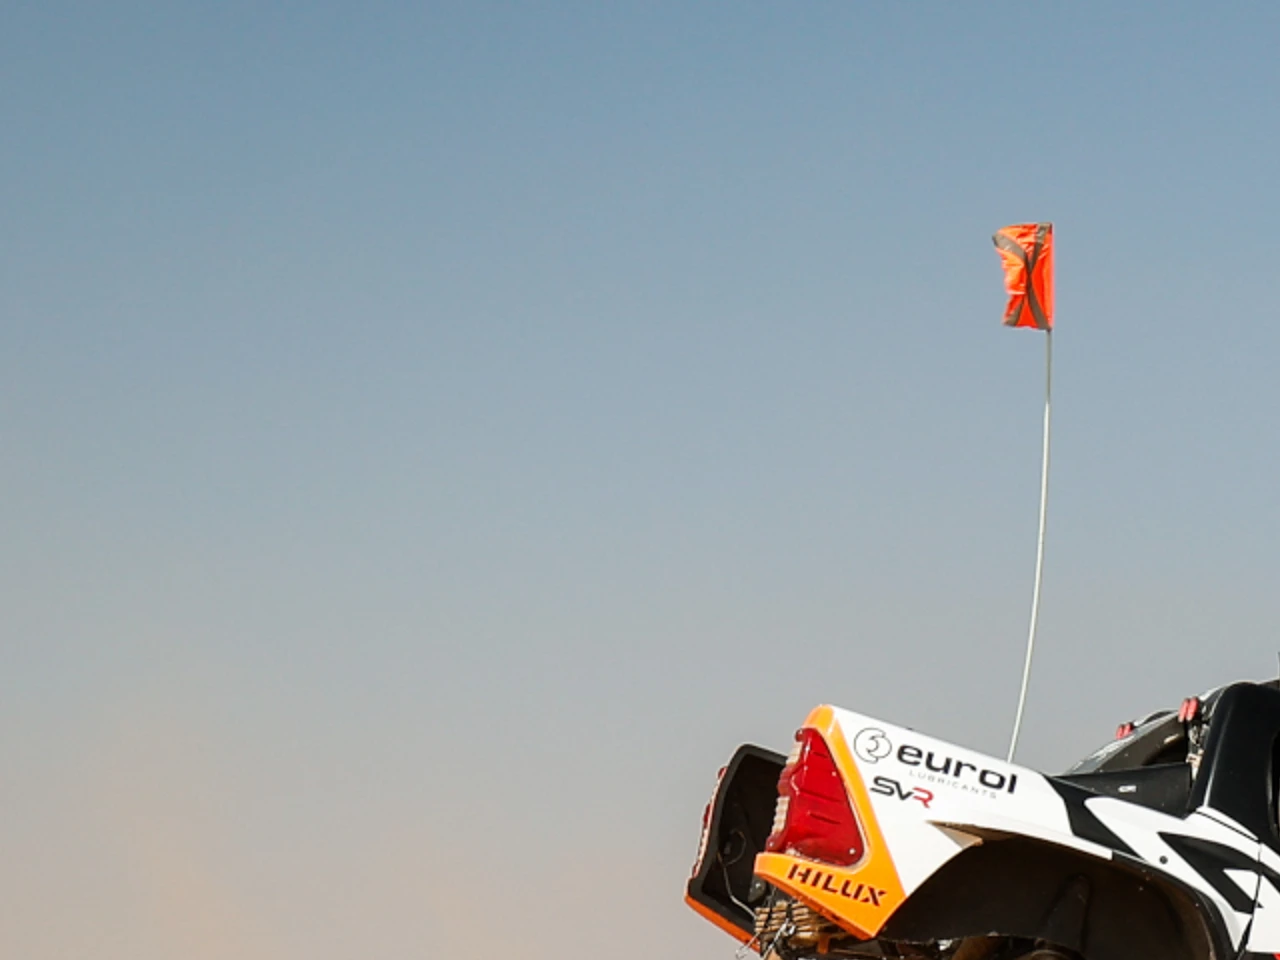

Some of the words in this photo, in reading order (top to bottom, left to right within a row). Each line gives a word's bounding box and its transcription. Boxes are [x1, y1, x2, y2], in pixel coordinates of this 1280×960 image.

[897, 744, 1018, 794] eurol
[909, 769, 997, 799] LUBRICANTS
[870, 776, 934, 808] SVR
[787, 862, 887, 908] HILUX
